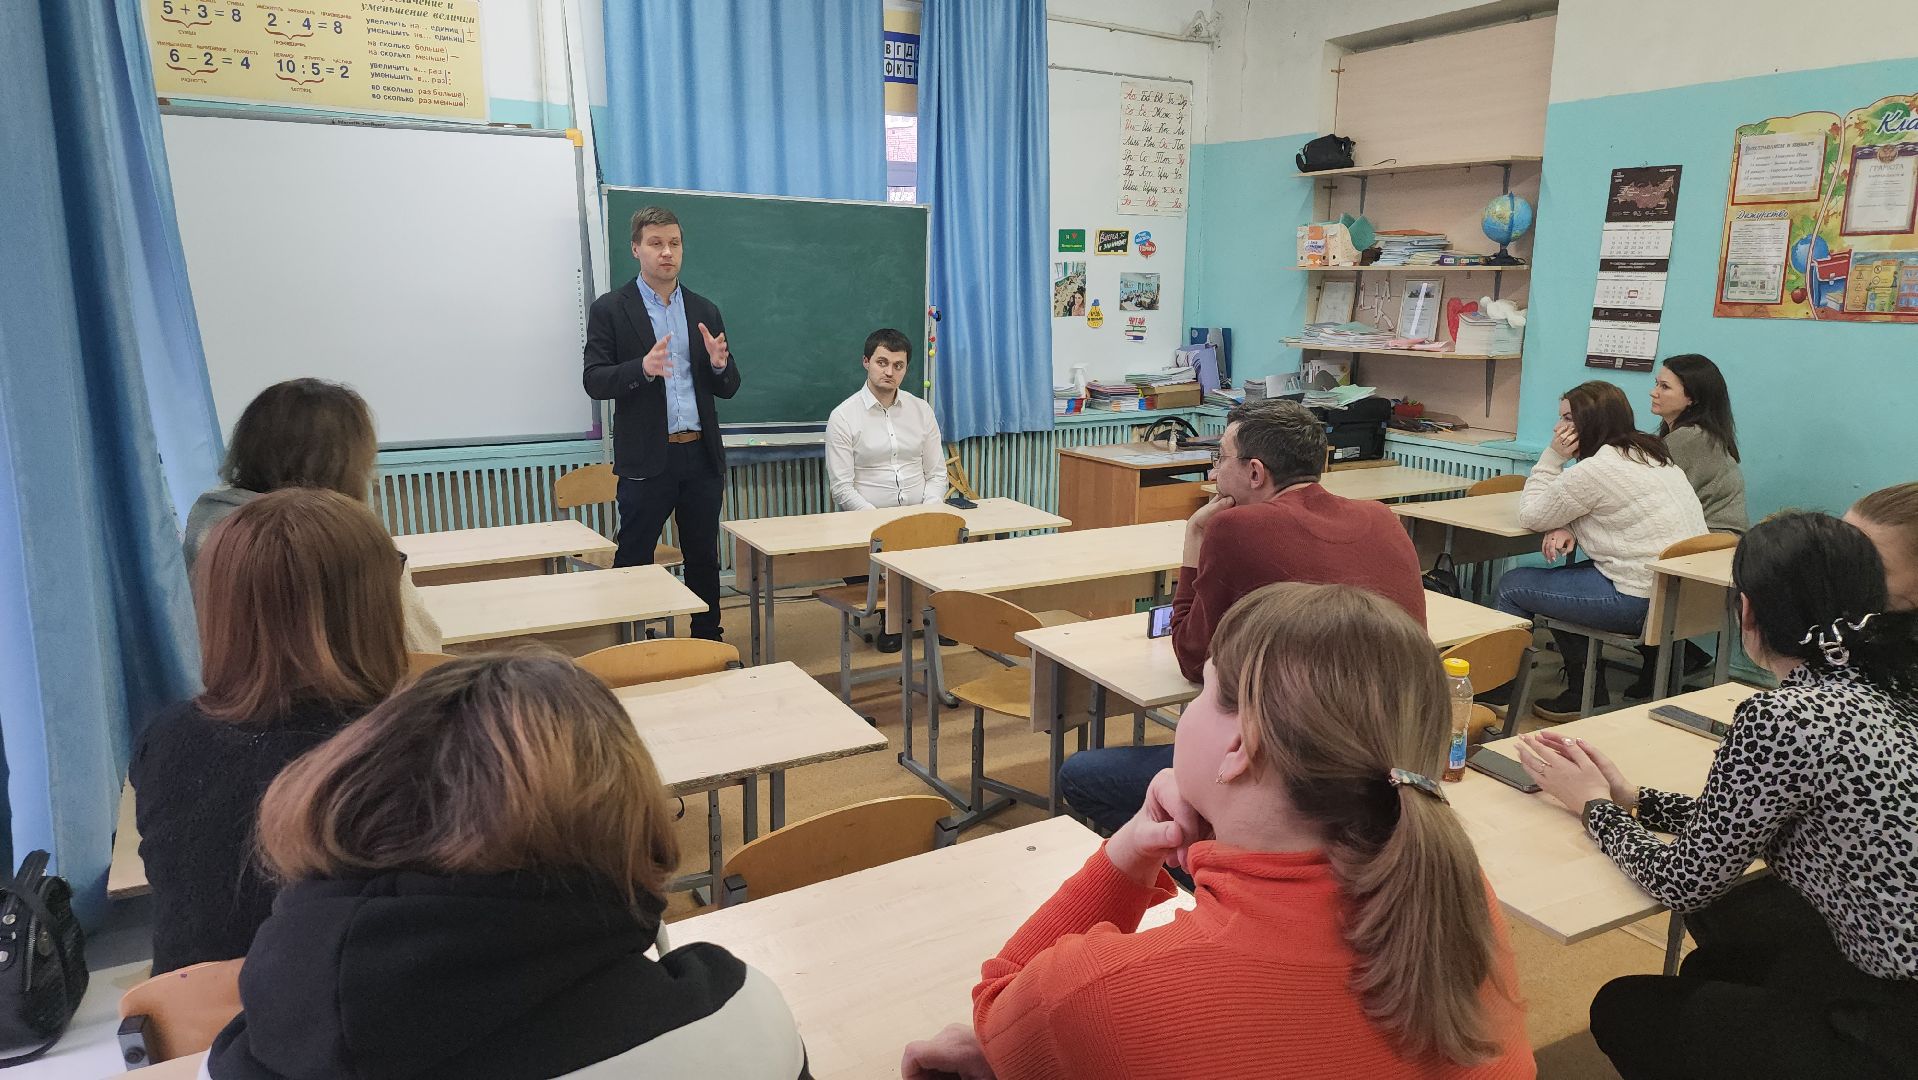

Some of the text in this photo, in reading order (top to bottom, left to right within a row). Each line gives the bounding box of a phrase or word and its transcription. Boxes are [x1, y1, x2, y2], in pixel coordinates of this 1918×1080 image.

[163, 0, 173, 14] 5
[198, 5, 208, 18] 3
[232, 8, 241, 22] 8
[267, 13, 277, 26] 2
[302, 17, 311, 30] 4
[333, 21, 343, 34] 8
[169, 49, 180, 62] 6
[203, 52, 213, 66] 2
[241, 57, 250, 69] 4
[277, 59, 296, 73] 10
[311, 63, 320, 75] 5
[340, 66, 349, 78] 2
